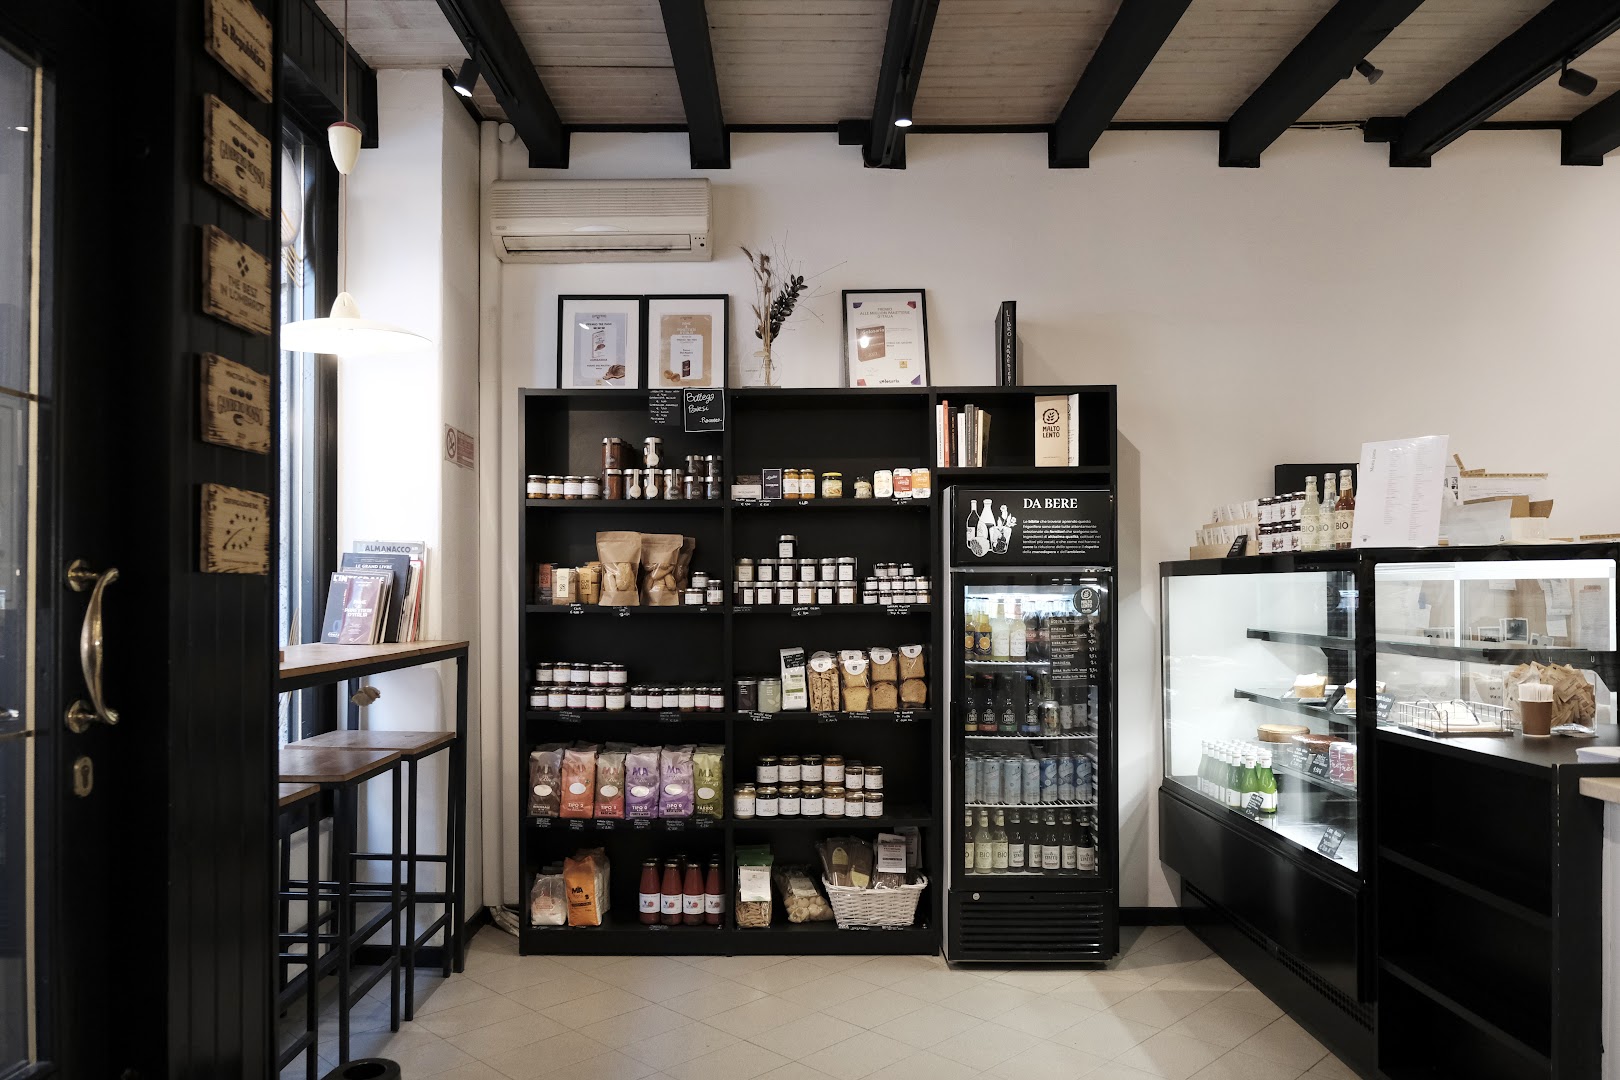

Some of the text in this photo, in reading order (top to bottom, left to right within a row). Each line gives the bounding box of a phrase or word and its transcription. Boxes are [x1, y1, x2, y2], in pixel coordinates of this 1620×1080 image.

[222, 16, 228, 36] la
[230, 24, 266, 72] Repubblica
[228, 274, 240, 290] THE
[1023, 498, 1078, 509] DA BERE
[1336, 521, 1349, 529] BIO
[365, 545, 411, 553] ALMANACCO
